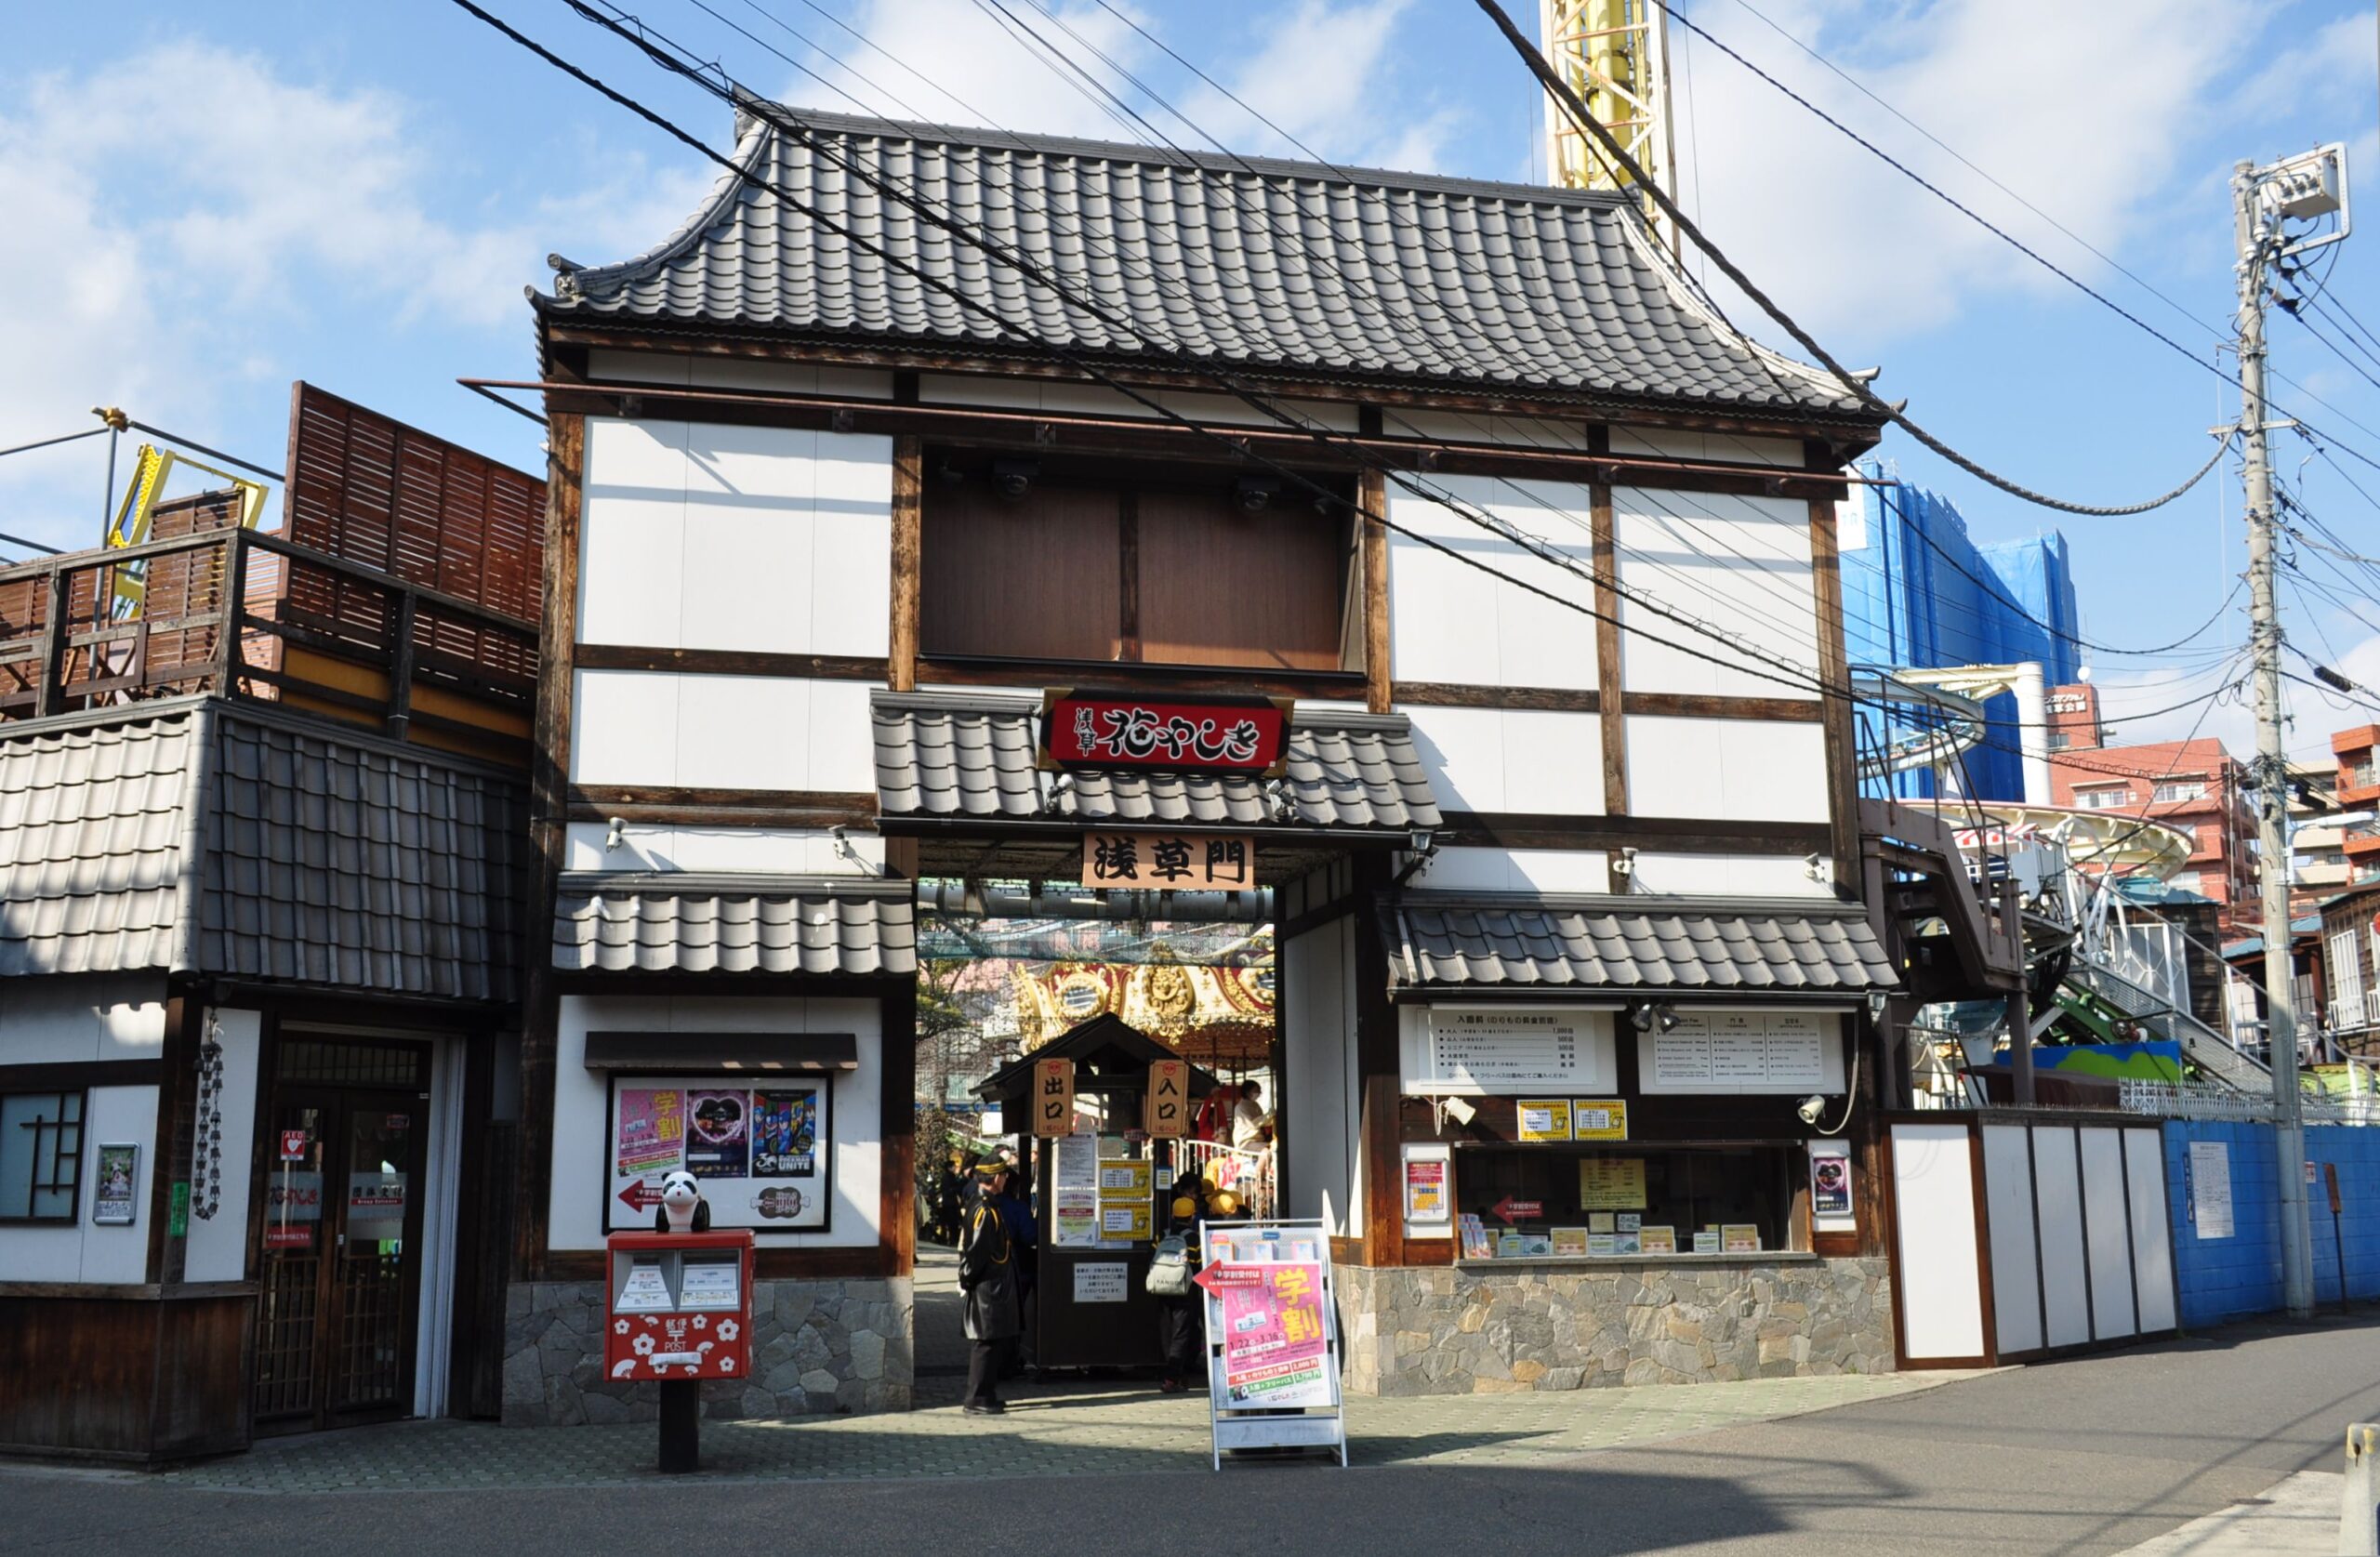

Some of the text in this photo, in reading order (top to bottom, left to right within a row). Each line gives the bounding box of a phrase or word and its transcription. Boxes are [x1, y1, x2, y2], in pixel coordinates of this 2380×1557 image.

[1075, 707, 1098, 757] 浅草
[1096, 706, 1260, 762] 花やしき
[1092, 837, 1246, 884] 浅草門
[654, 1090, 682, 1141] 学割
[1043, 1076, 1064, 1120] 出口
[1157, 1076, 1178, 1120] 入口
[284, 1130, 304, 1139] AED
[778, 1161, 810, 1171] UNITE
[665, 1318, 687, 1331] 郵便
[1274, 1267, 1322, 1344] 学割
[665, 1340, 687, 1352] POST
